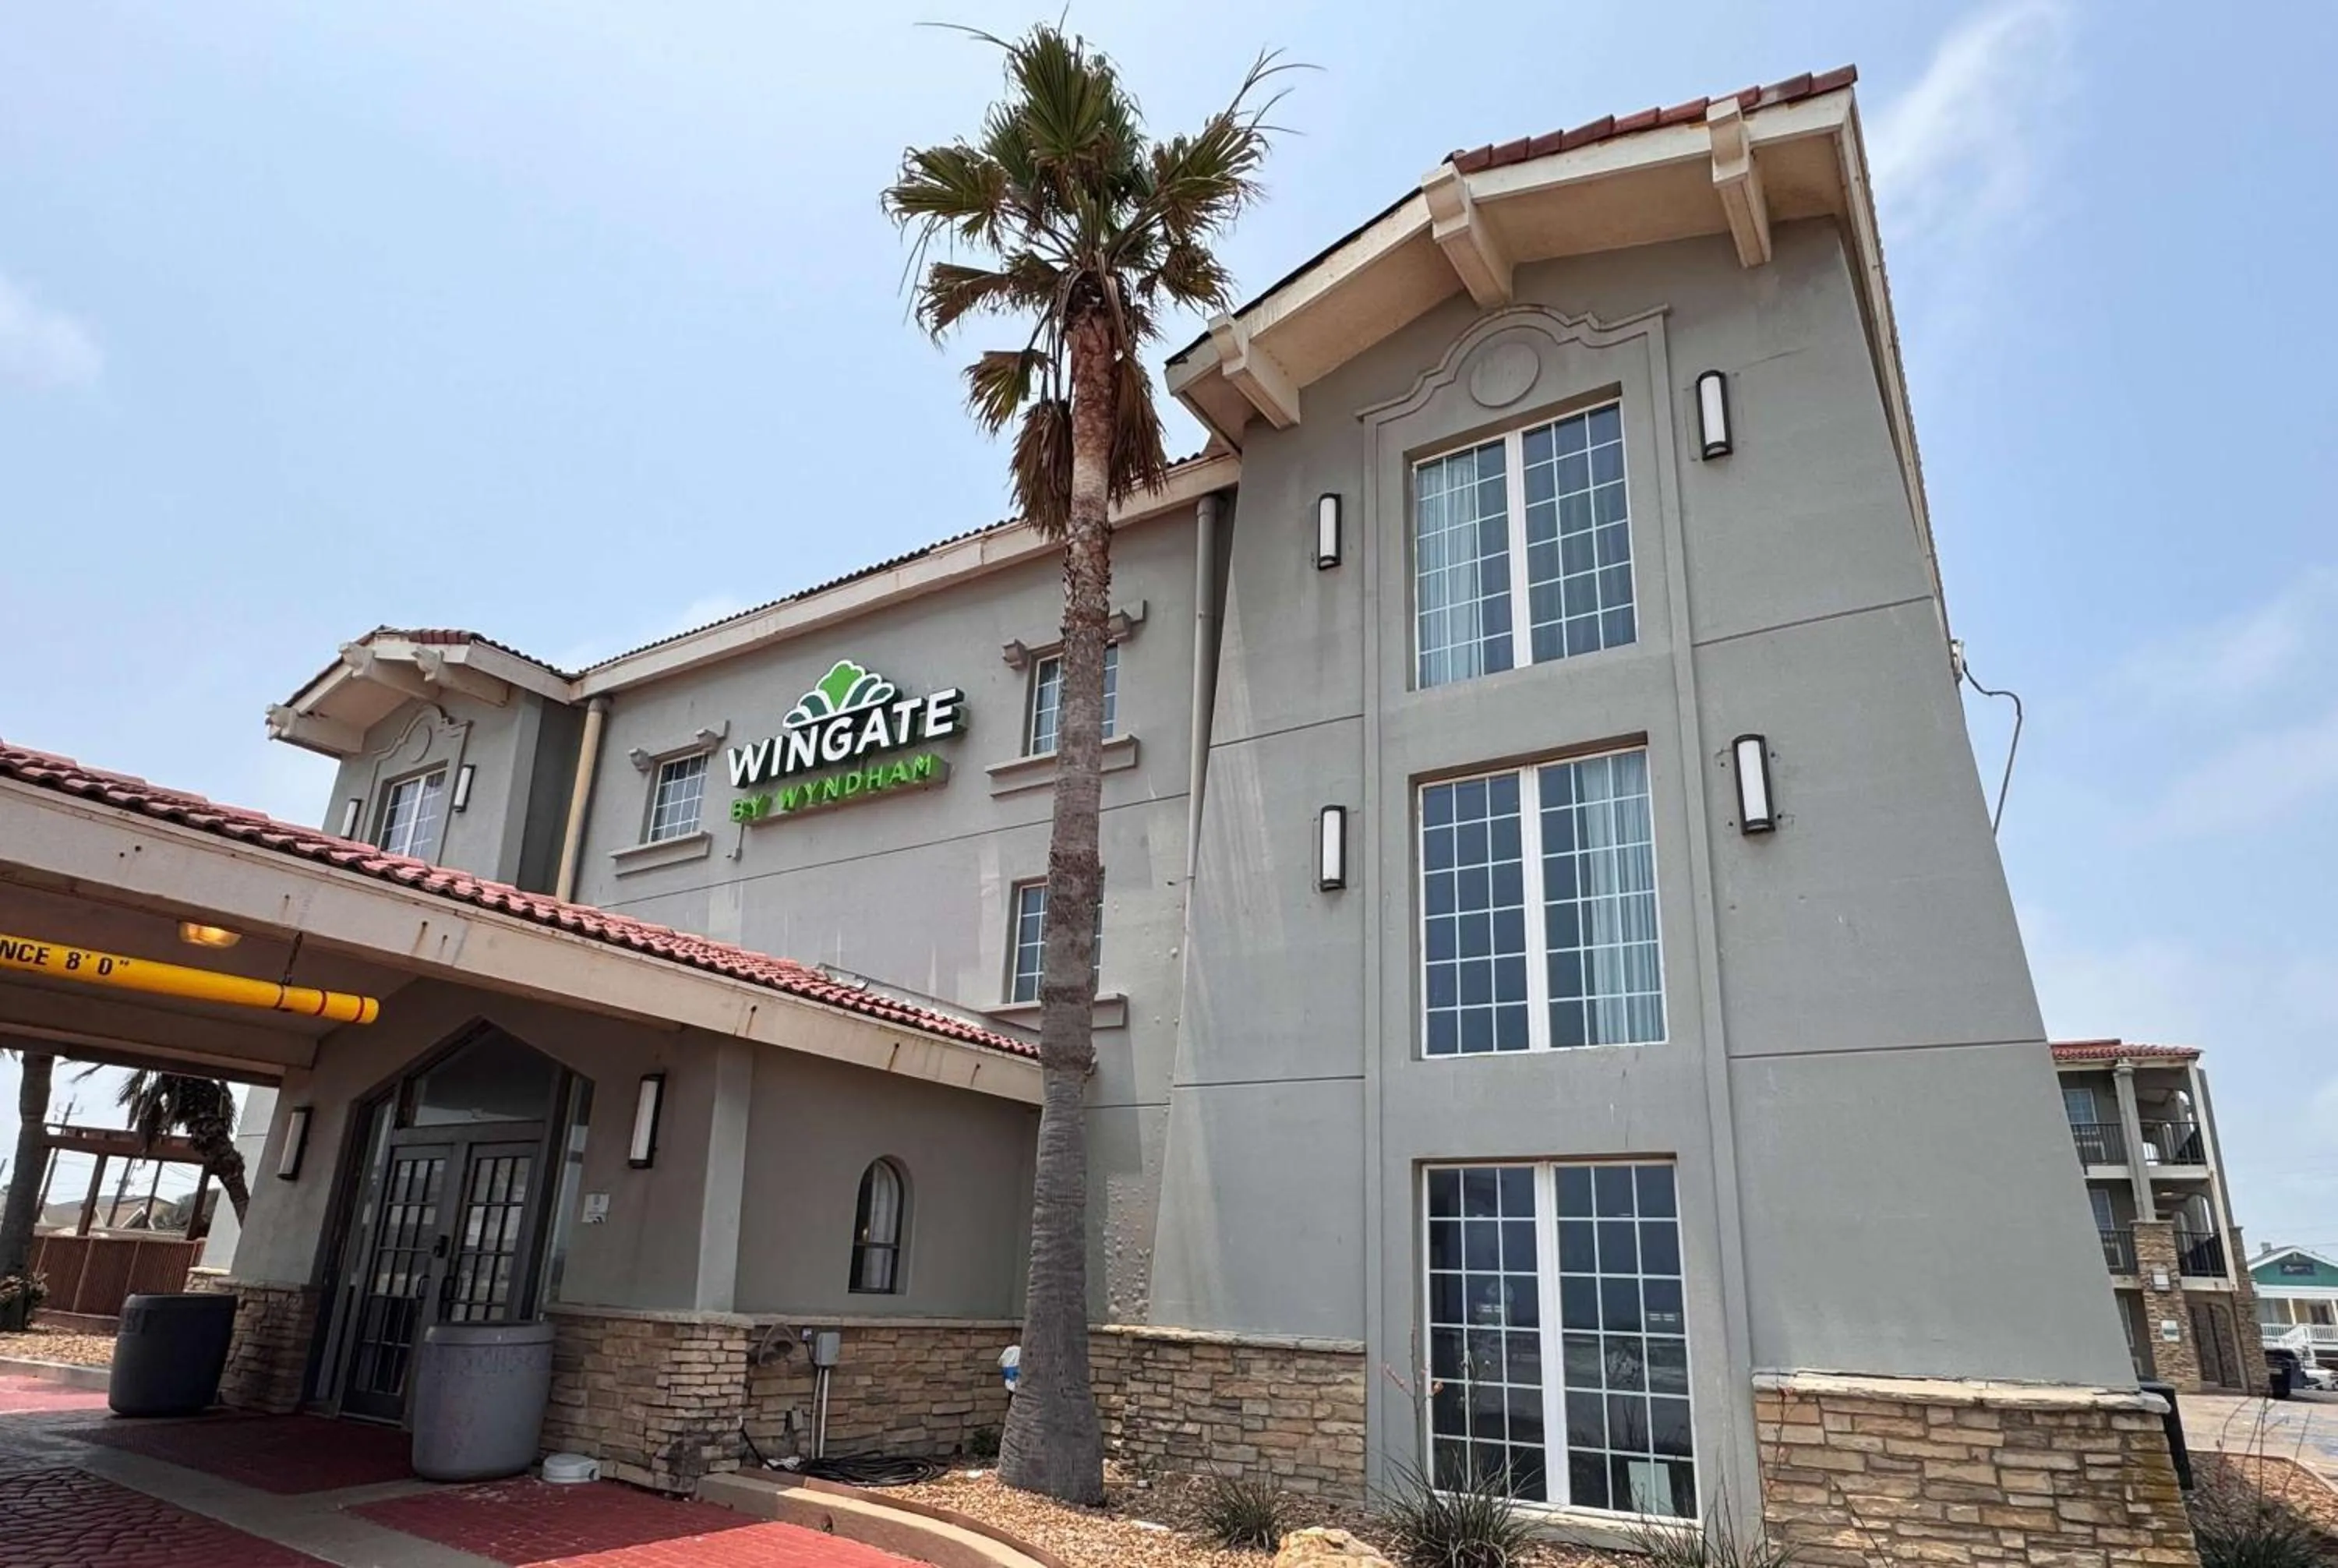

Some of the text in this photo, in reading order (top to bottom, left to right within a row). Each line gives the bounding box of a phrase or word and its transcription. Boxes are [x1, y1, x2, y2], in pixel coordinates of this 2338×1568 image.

[727, 688, 957, 787] WINGATE
[731, 753, 934, 822] BY WYNDHAM
